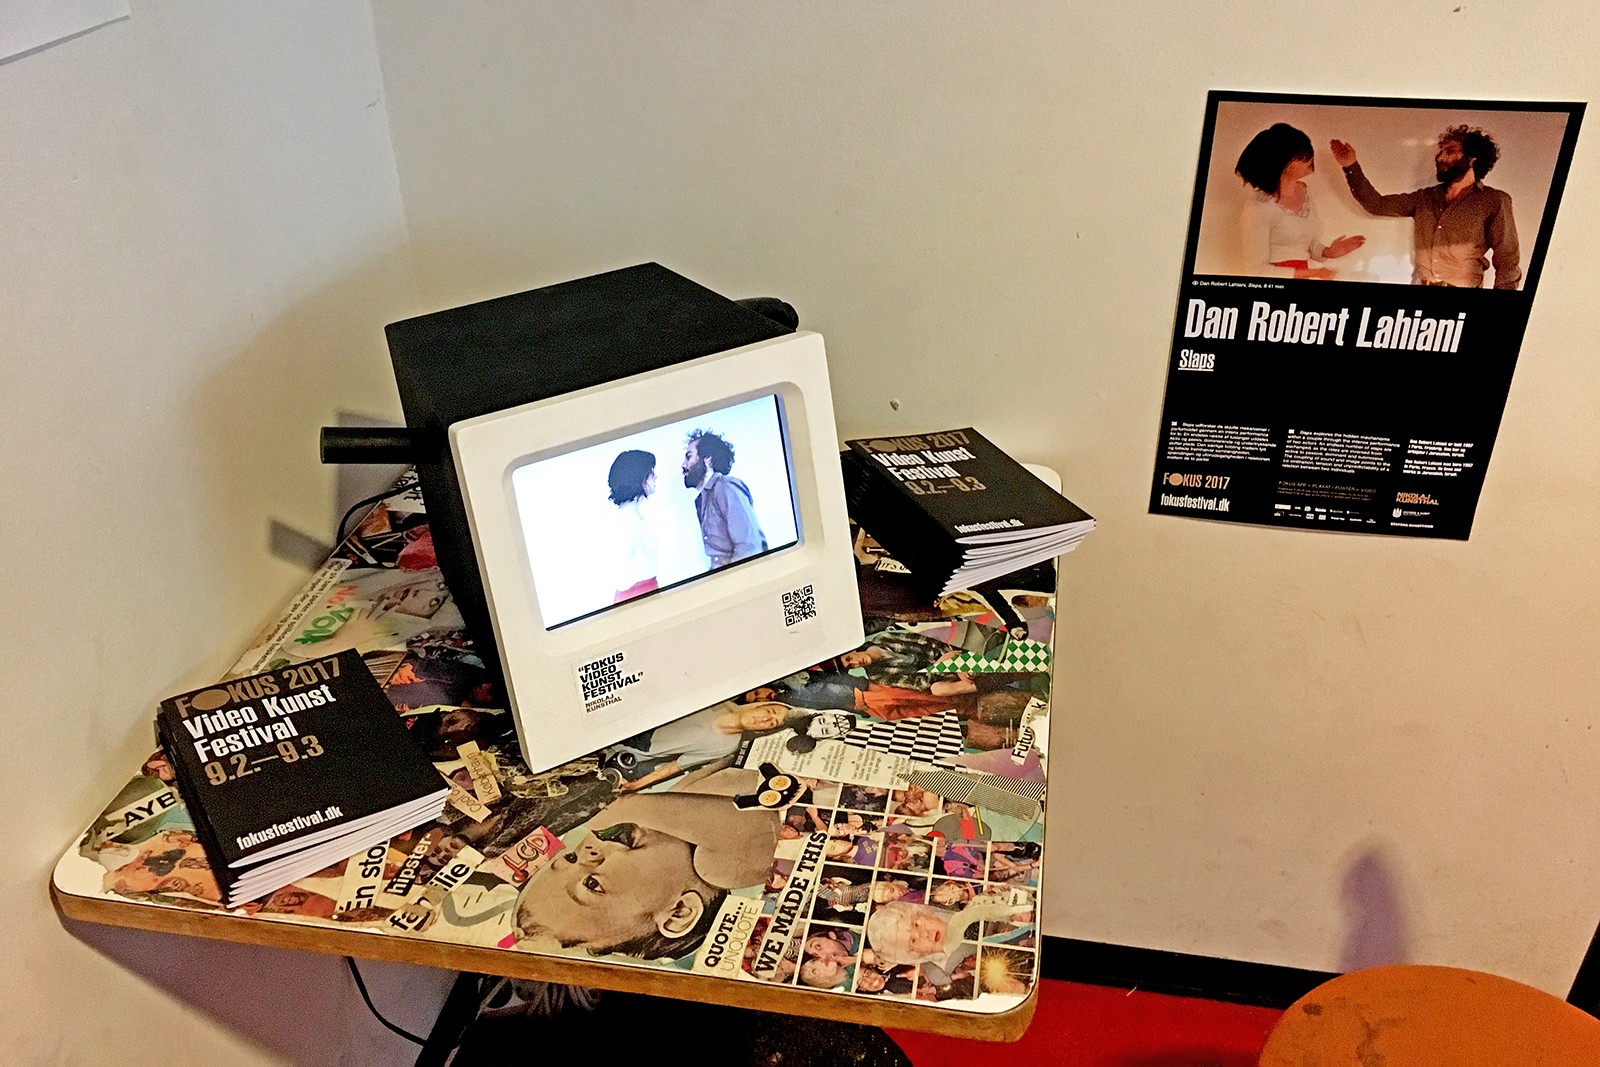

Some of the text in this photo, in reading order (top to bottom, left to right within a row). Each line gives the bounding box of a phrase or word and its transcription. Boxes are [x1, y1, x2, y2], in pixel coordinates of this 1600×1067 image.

[1184, 298, 1466, 353] Dan Robert Lahiani
[1179, 349, 1216, 370] Slaps
[929, 431, 970, 449] 2017
[871, 446, 977, 468] Video Kunst
[886, 463, 962, 482] Festival
[1204, 475, 1231, 490] 2017
[1160, 493, 1230, 512] fokusfestival.dk
[282, 657, 341, 690] 2017
[580, 664, 618, 684] VIDEO
[581, 670, 623, 692] KUNST
[182, 684, 336, 740] Video Kunst
[585, 694, 615, 708] NIKOLAJ
[586, 696, 623, 713] KUNSTHAL
[193, 718, 299, 763] Festival
[456, 791, 483, 815] Cool
[236, 805, 344, 850] fokusfestival.dk
[387, 833, 432, 895] hipster-
[755, 831, 828, 973] WE MADE THIS
[720, 905, 759, 972] UNQUOTE
